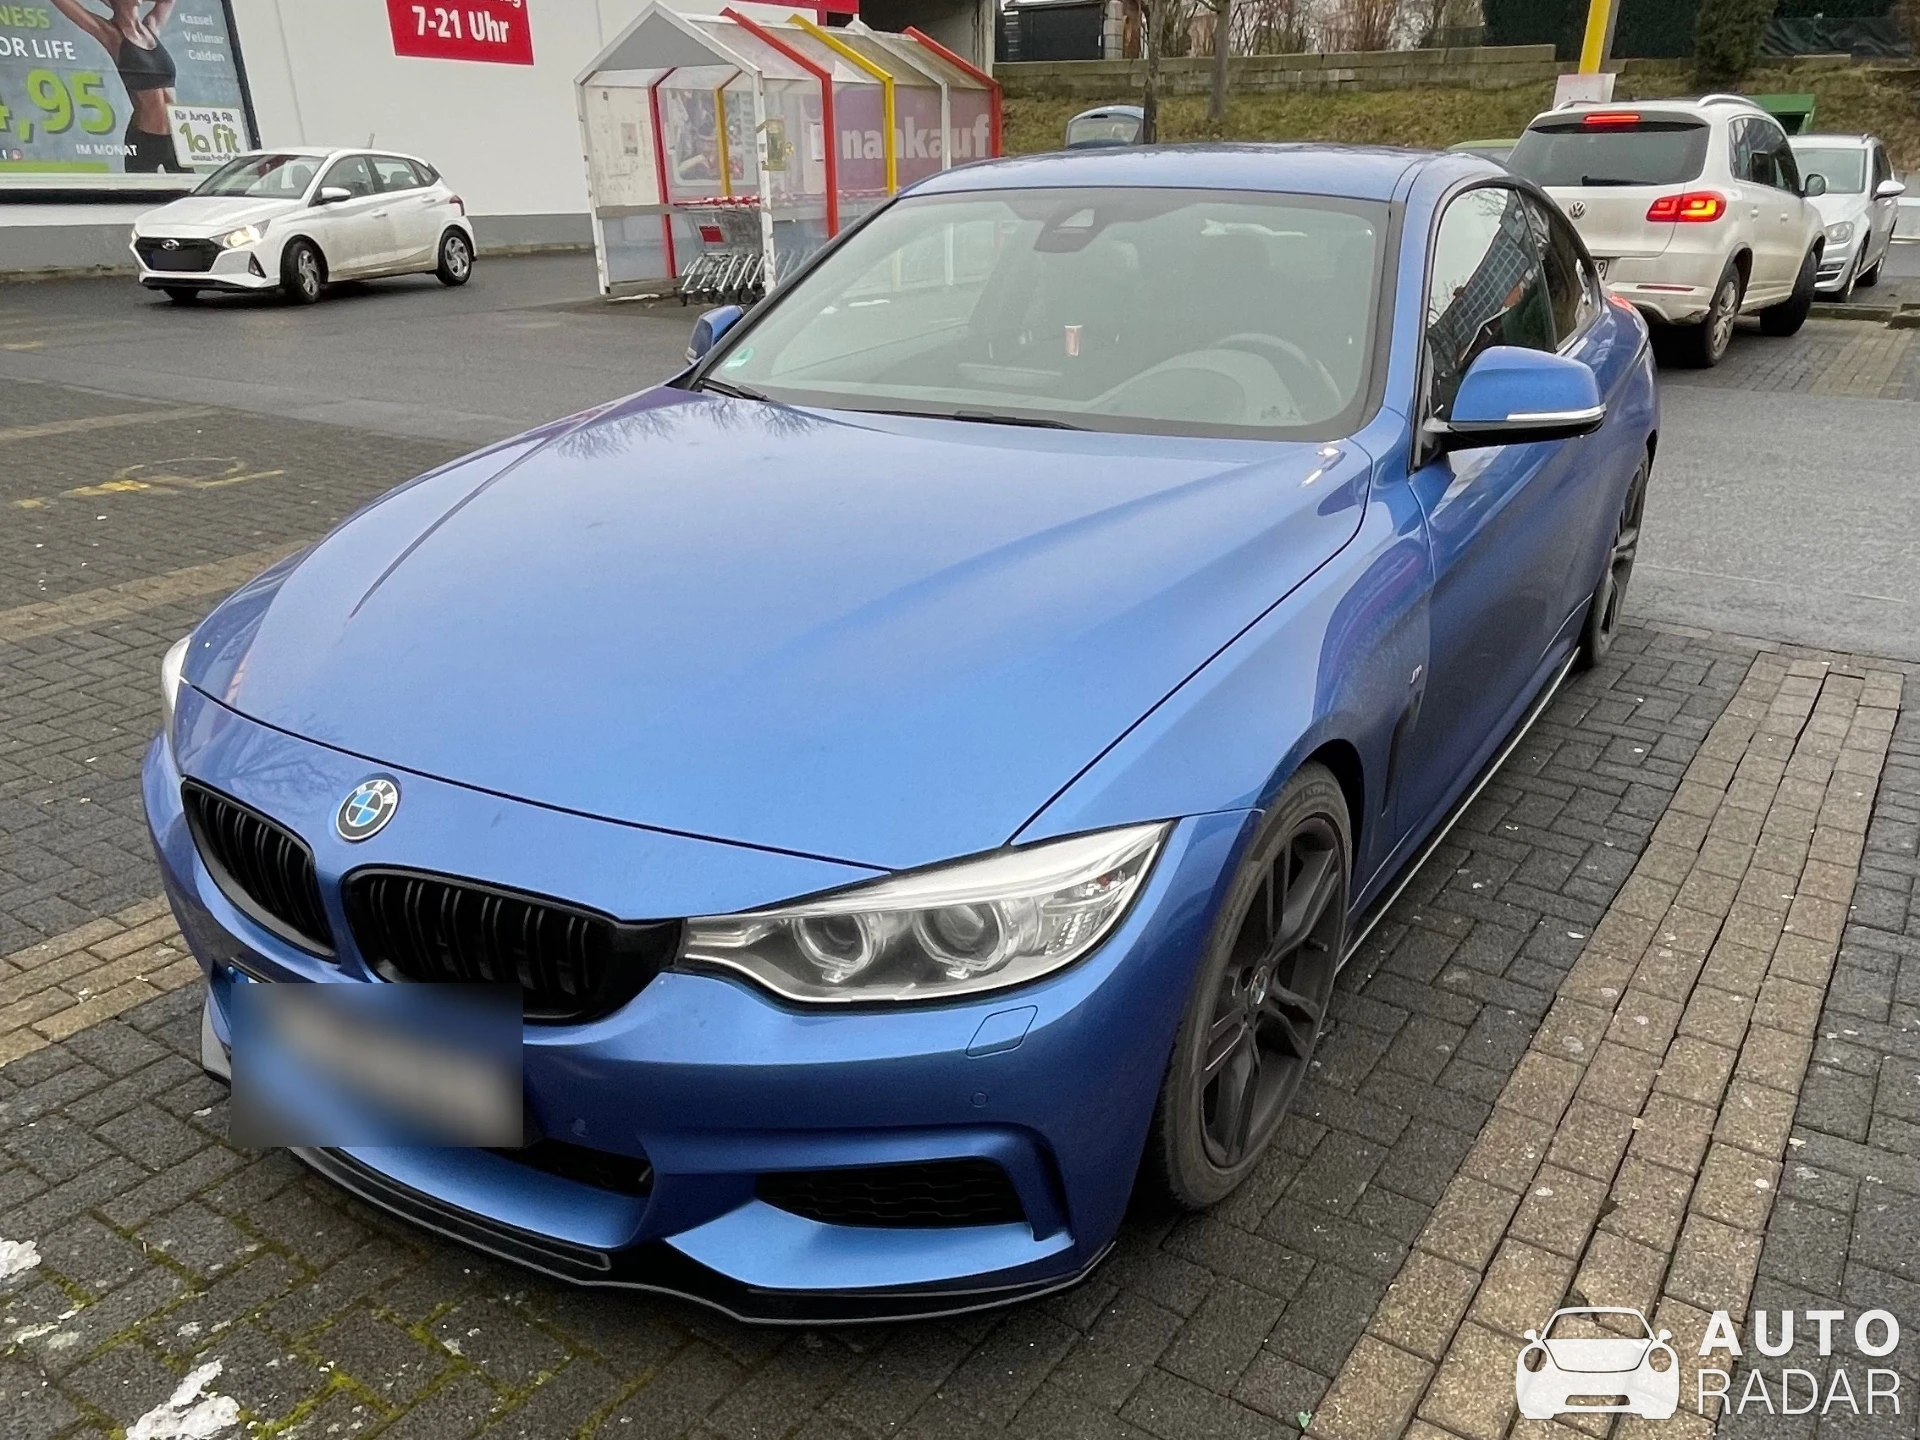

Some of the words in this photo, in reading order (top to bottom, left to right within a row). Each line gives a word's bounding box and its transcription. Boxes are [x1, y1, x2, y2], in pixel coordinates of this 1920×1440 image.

[180, 12, 214, 26] Kassel
[411, 5, 462, 39] 7-21
[468, 10, 509, 43] Uhr
[31, 39, 76, 60] LIFE
[188, 49, 225, 62] Calden
[213, 123, 241, 154] fit
[76, 144, 91, 155] IM
[94, 144, 137, 156] MONAT
